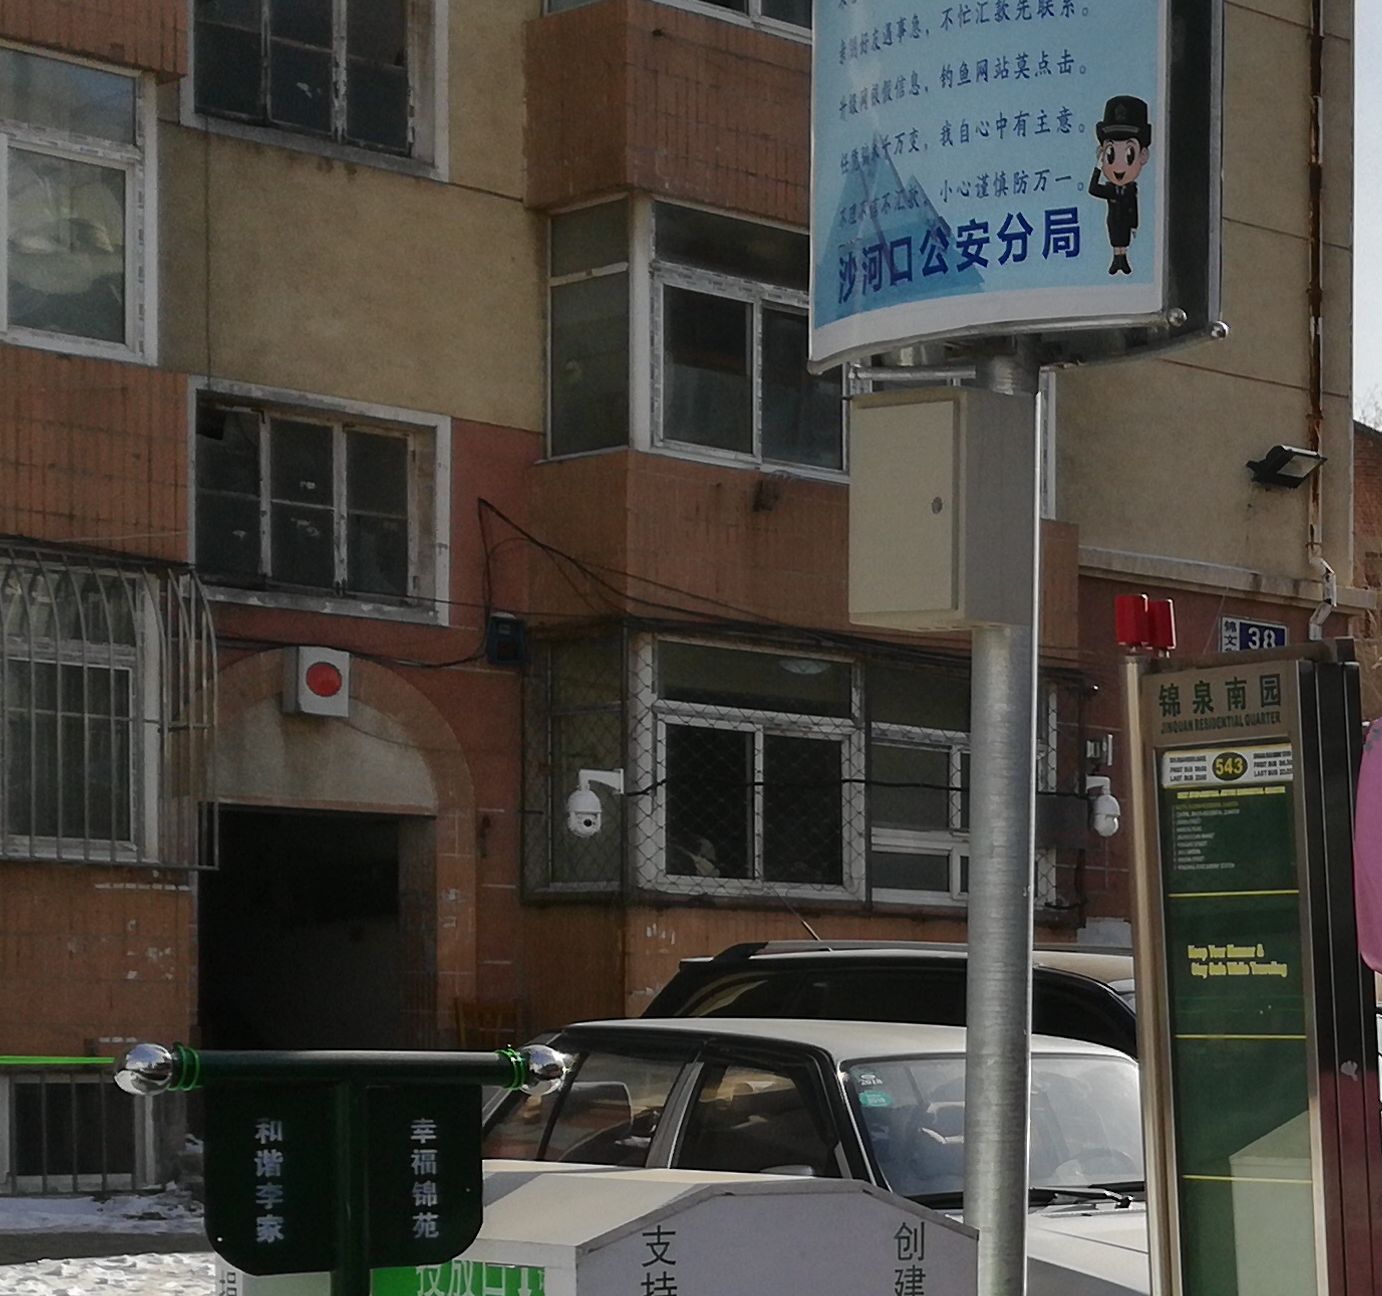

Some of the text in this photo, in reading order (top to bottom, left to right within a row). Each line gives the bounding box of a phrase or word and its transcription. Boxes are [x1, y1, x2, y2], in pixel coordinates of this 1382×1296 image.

[838, 207, 1081, 304] 沙河口公安分局
[1224, 620, 1238, 652] 锦文
[1248, 626, 1277, 650] 38
[1158, 673, 1281, 718] 锦泉南园
[1215, 756, 1244, 776] 543
[254, 1117, 285, 1244] 和谐李家
[410, 1118, 440, 1240] 幸福锦苑
